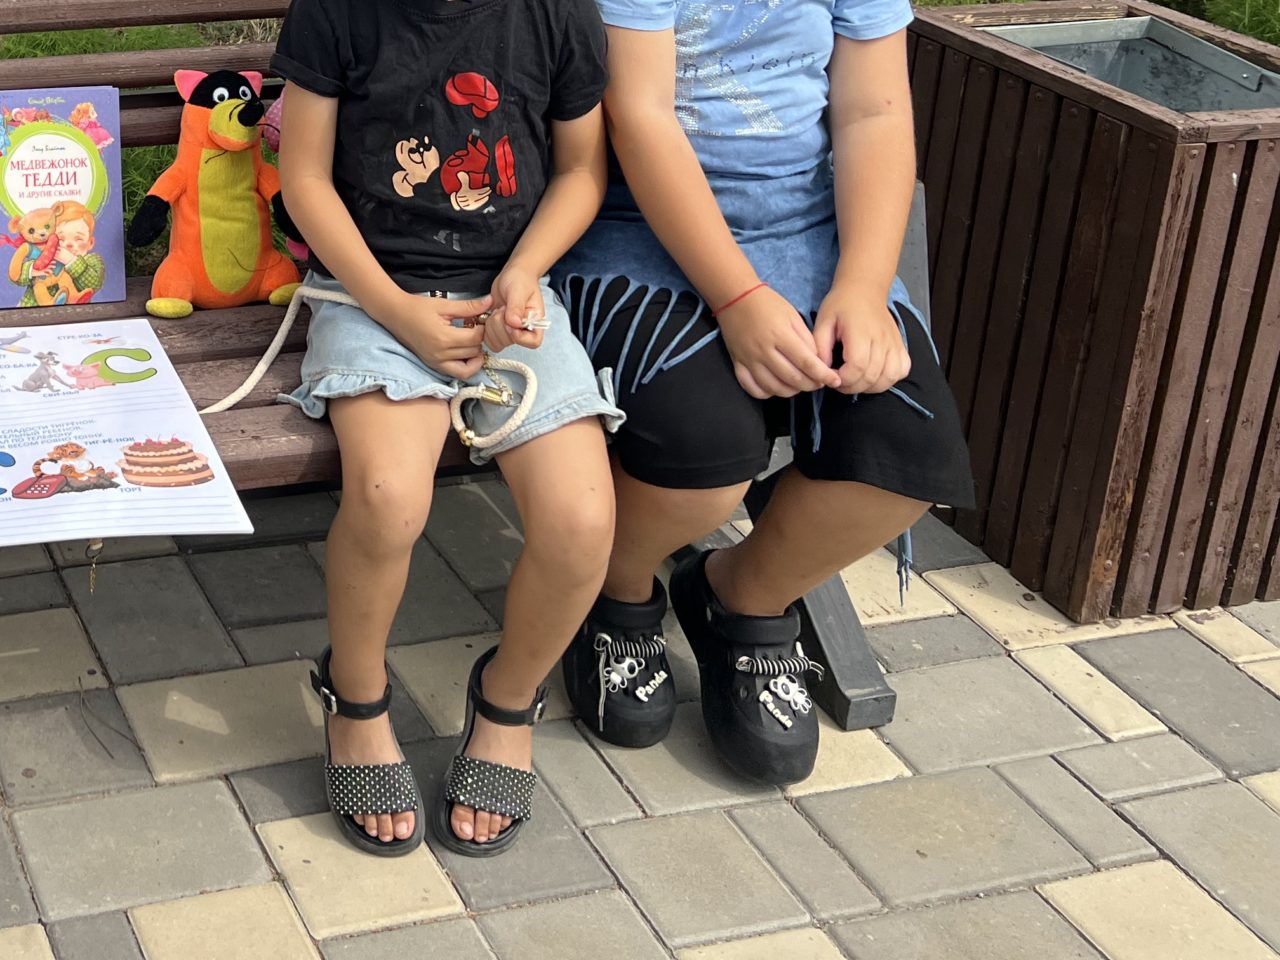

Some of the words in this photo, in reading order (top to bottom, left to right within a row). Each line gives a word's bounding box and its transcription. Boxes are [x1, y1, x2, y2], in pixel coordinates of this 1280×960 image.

[10, 157, 88, 171] МЕДВЕЖОНОК
[22, 171, 78, 188] ТЕДДИ
[26, 190, 52, 200] ДРУГИЕ
[53, 189, 82, 197] СКАЗКИ
[81, 347, 158, 384] С
[635, 670, 668, 702] Panda
